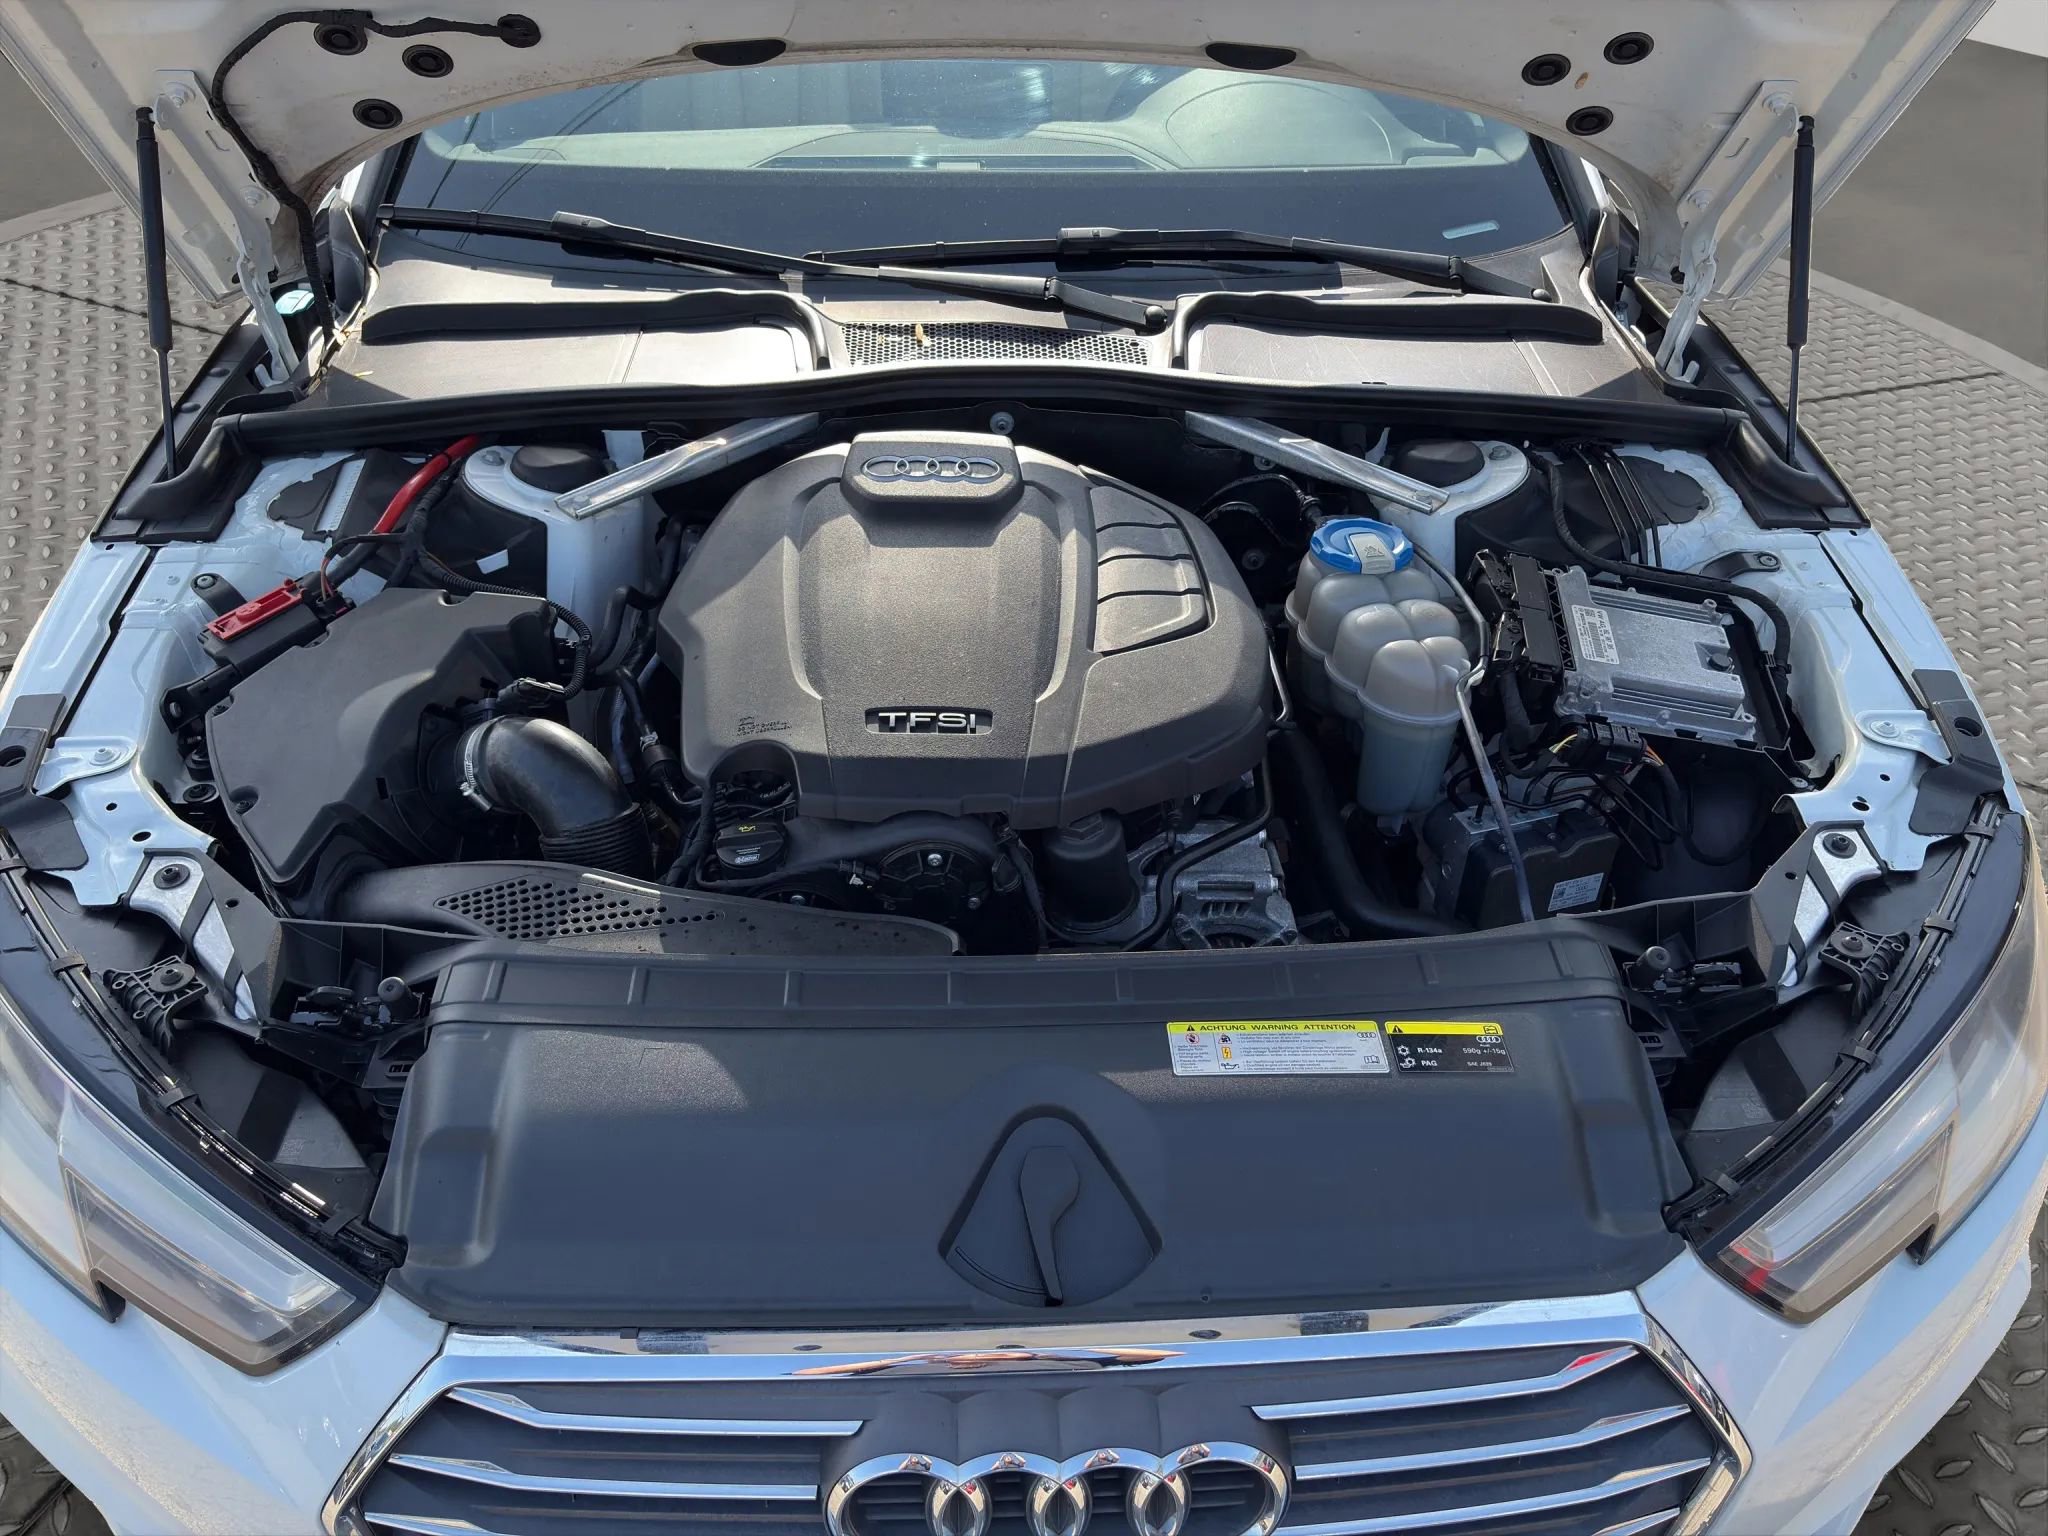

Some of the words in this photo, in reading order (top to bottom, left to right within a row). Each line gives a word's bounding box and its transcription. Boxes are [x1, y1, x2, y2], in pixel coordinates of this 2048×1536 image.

[878, 711, 976, 729] TFSI
[1199, 1024, 1247, 1032] ACHTUNG
[1303, 1023, 1357, 1031] ATTENTION
[1462, 1047, 1481, 1055] 590g
